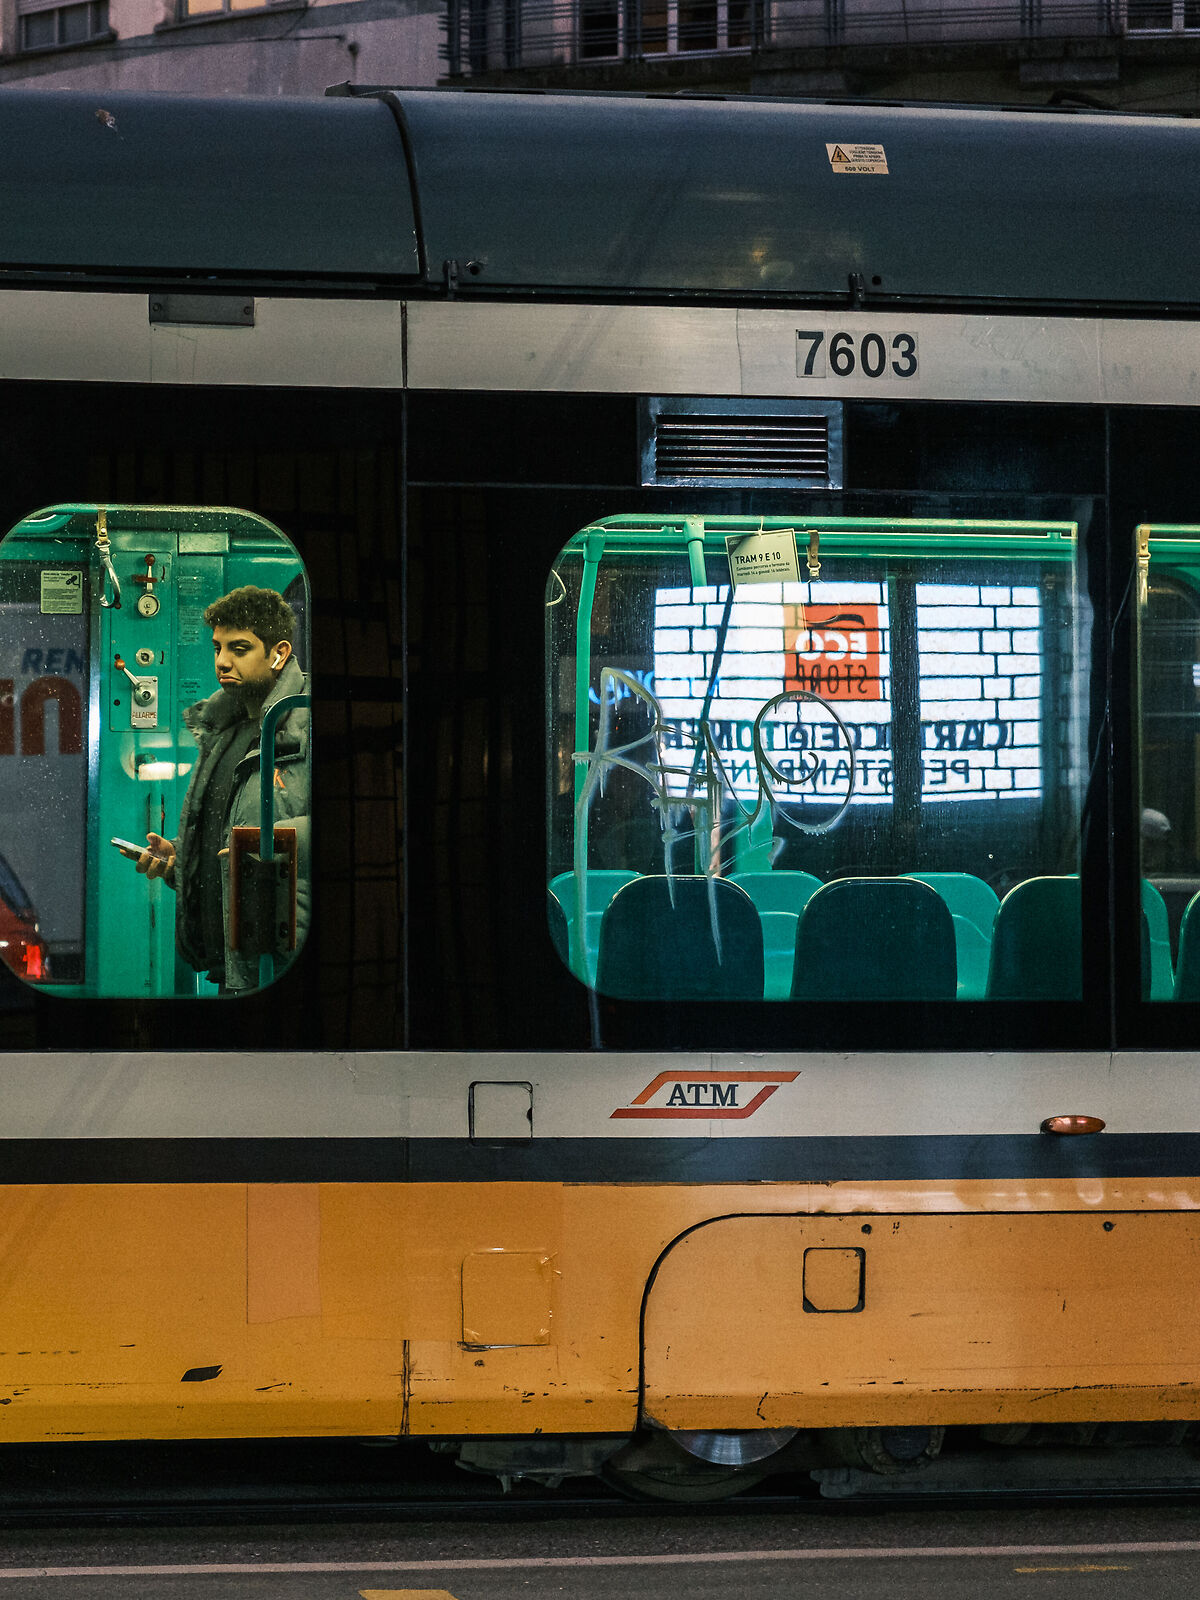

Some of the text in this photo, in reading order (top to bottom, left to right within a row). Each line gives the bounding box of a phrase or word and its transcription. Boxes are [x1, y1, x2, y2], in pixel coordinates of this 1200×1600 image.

[798, 331, 918, 378] 7603
[735, 552, 781, 564] TRAM 9 E 10
[666, 1083, 739, 1106] ATM
